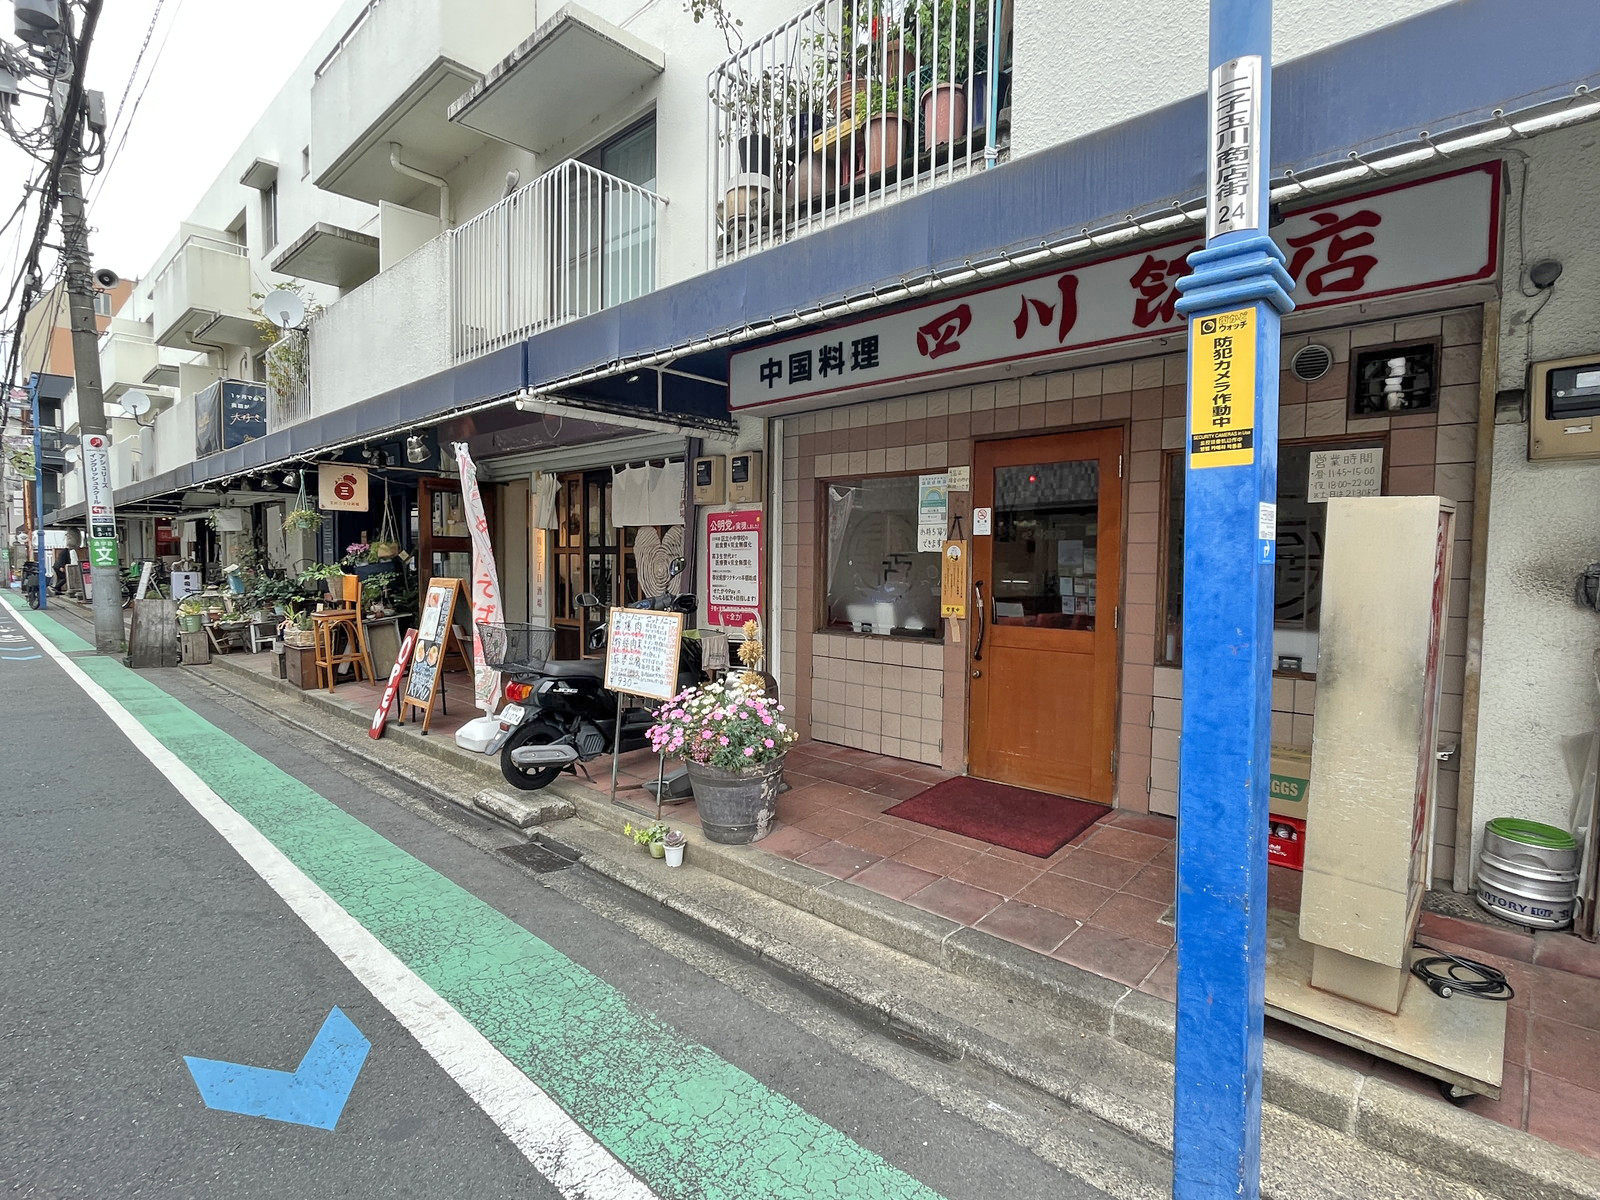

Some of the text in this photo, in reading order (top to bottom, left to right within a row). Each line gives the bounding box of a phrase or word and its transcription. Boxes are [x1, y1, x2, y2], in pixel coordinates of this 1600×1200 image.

[1216, 76, 1251, 201] 二子玉川商店街
[1218, 202, 1246, 224] 24
[1218, 320, 1248, 333] ウォッチ
[760, 334, 880, 389] 中国料理
[1212, 336, 1233, 428] 防犯カメラ作動中
[1193, 433, 1215, 441] SECURITY
[99, 453, 109, 489] アシュリーズ
[1315, 453, 1373, 469] 営業時間
[95, 547, 114, 562] 文
[371, 635, 412, 731] OPEN
[1270, 780, 1299, 797] GGS
[1480, 887, 1528, 913] UNTORY
